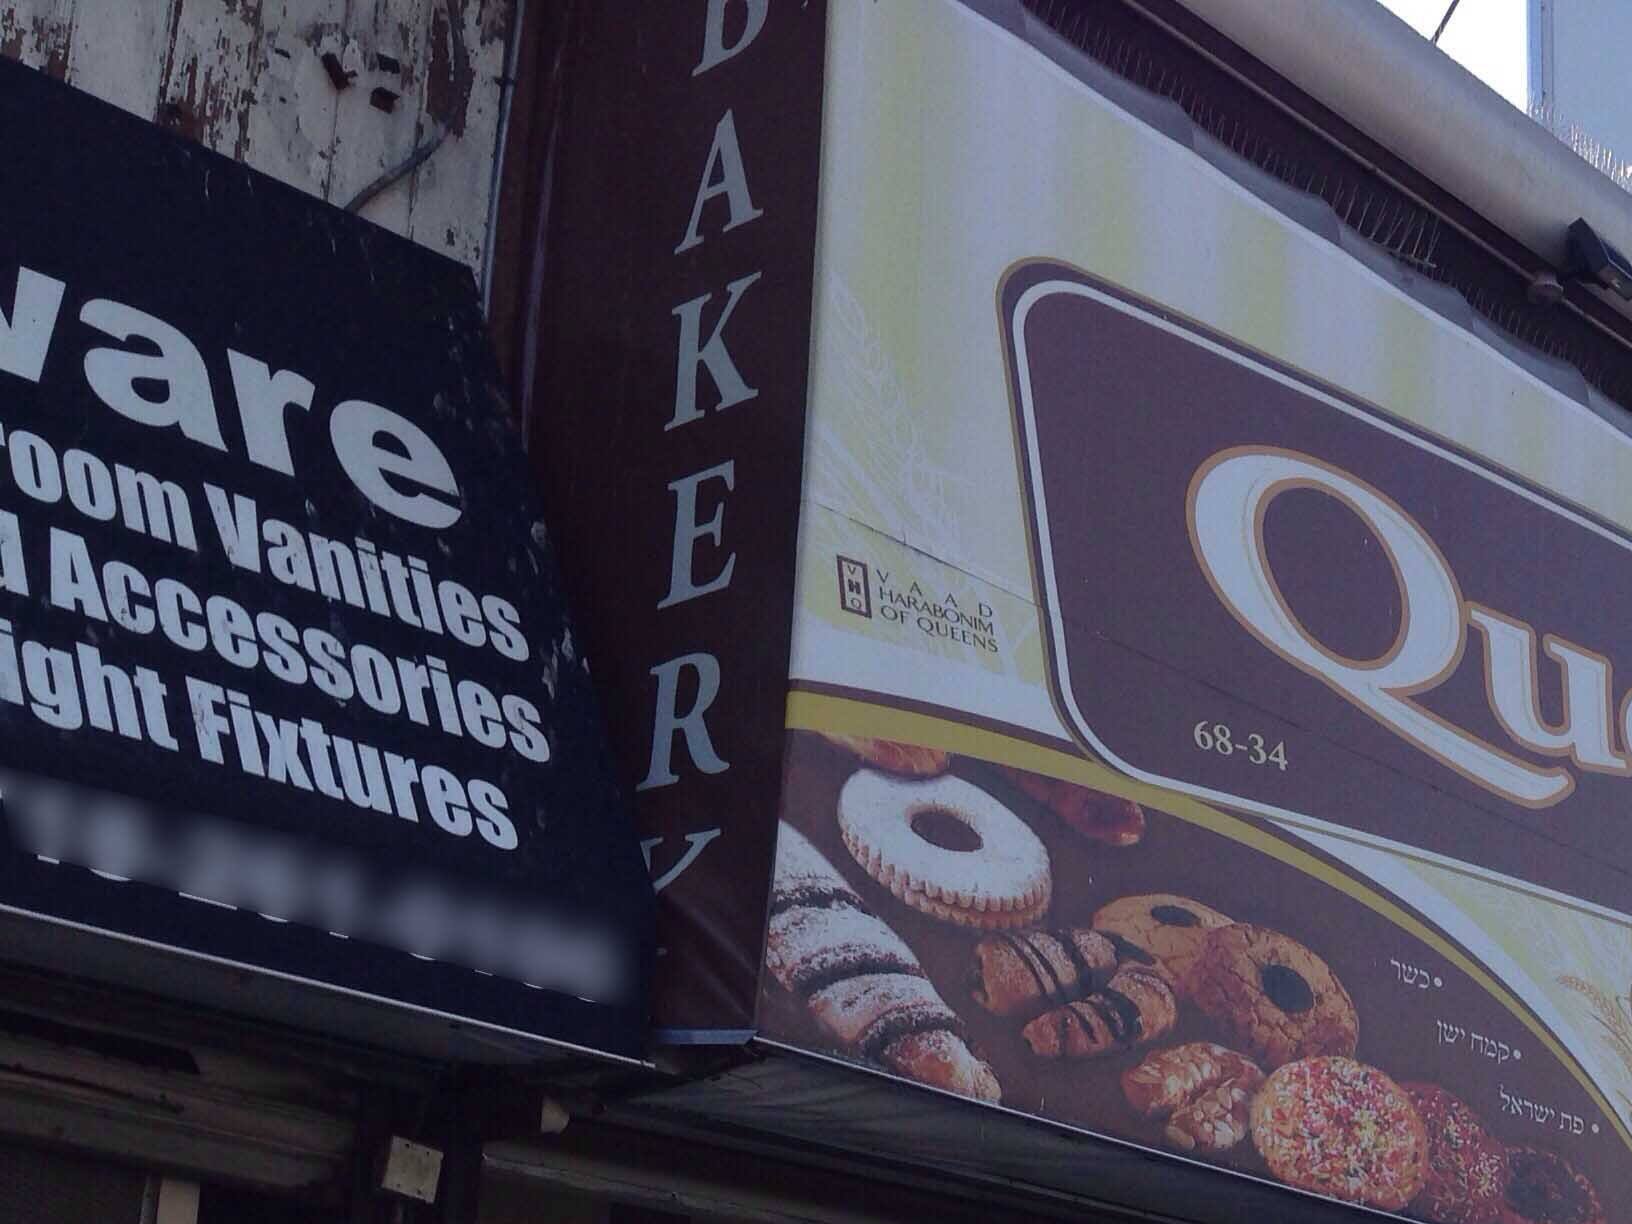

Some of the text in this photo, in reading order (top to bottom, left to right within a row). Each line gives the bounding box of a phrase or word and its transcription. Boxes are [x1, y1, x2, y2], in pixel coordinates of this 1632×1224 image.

[0, 422, 198, 553] oom
[203, 482, 529, 662] Vanities
[879, 587, 995, 636] HARABONIM
[881, 604, 999, 653] OF QUEENS
[50, 527, 550, 763] Accessories
[185, 676, 519, 851] Fixtures
[1193, 720, 1289, 772] 68-34
[1390, 957, 1431, 989] כשר
[1499, 1082, 1585, 1136] פת ישראל
